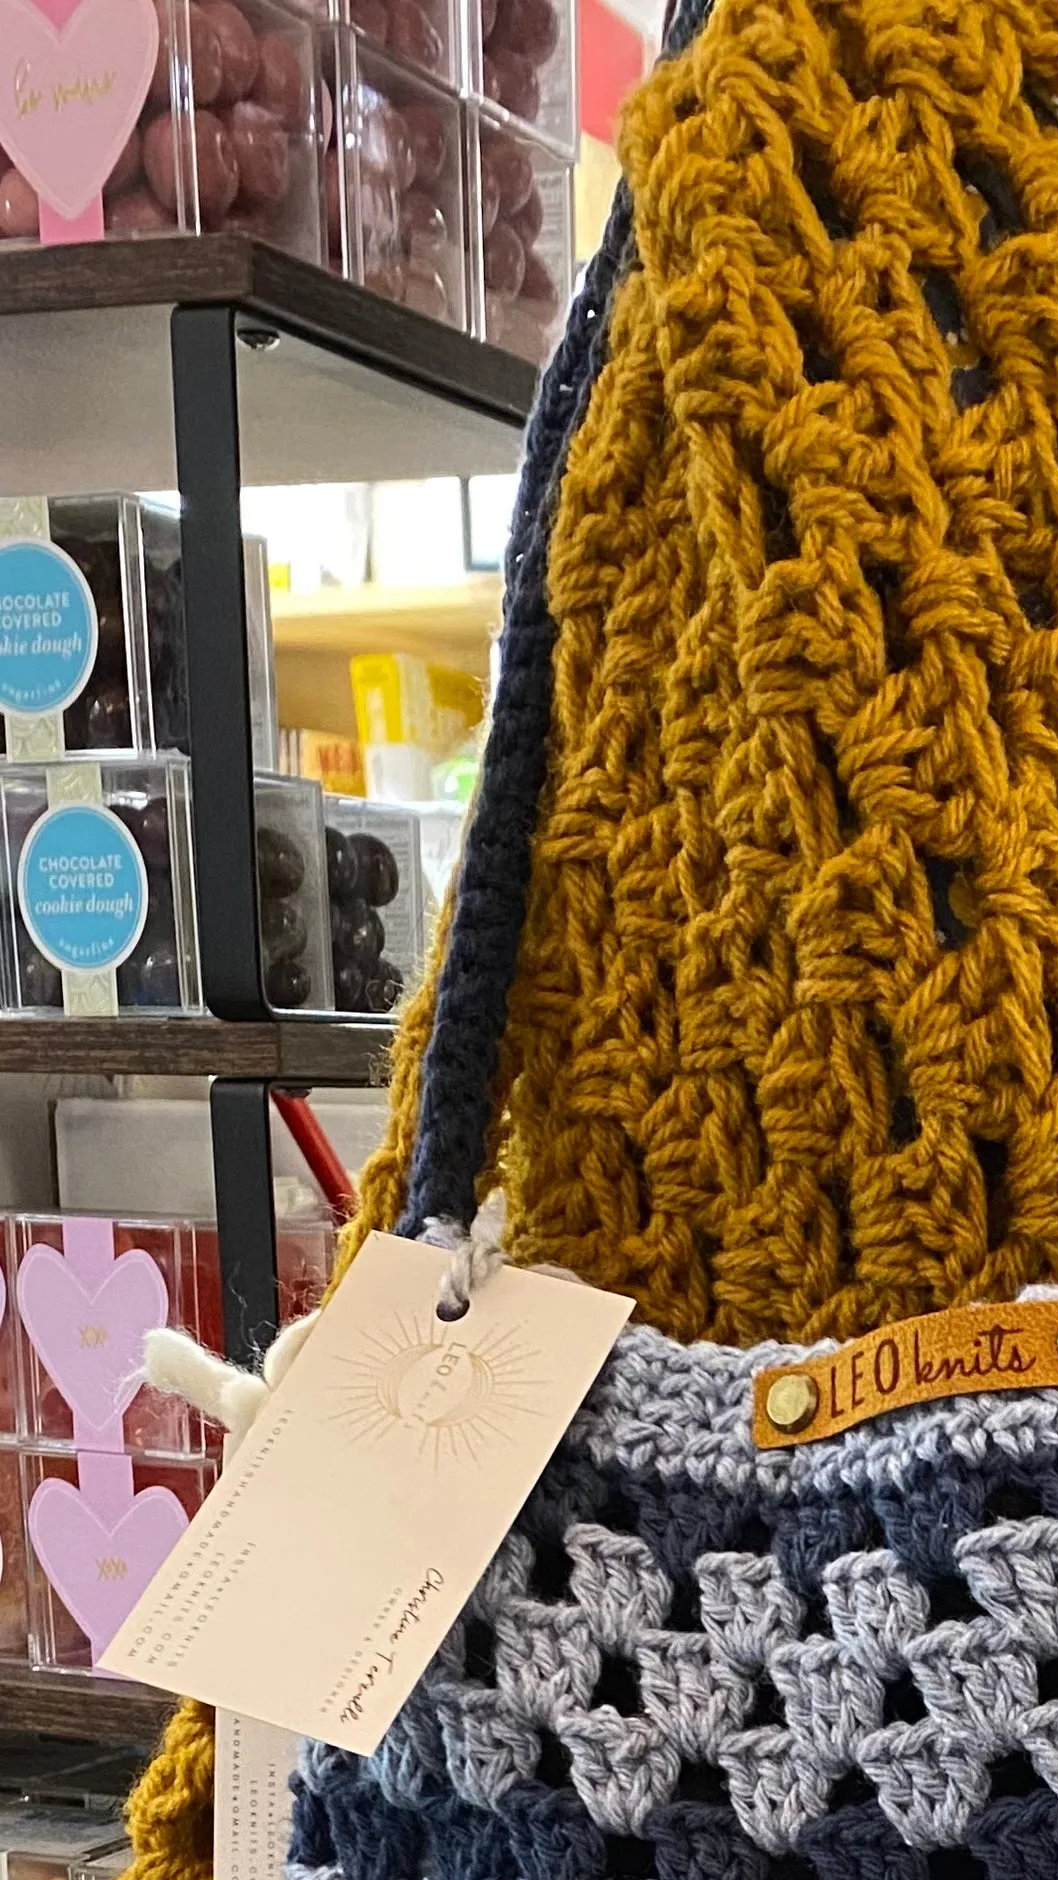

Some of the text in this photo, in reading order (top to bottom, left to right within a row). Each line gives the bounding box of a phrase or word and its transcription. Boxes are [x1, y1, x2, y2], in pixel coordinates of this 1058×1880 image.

[0, 592, 70, 611] OCOLATE
[0, 611, 62, 629] OVERED
[31, 631, 82, 661] dough
[38, 854, 123, 873] CHOCOLATE
[48, 872, 115, 890] COVERED
[35, 891, 134, 919] cookie dough
[436, 1341, 468, 1377] LEO
[831, 1323, 1037, 1418] LEO knits
[389, 1567, 445, 1645] Christine
